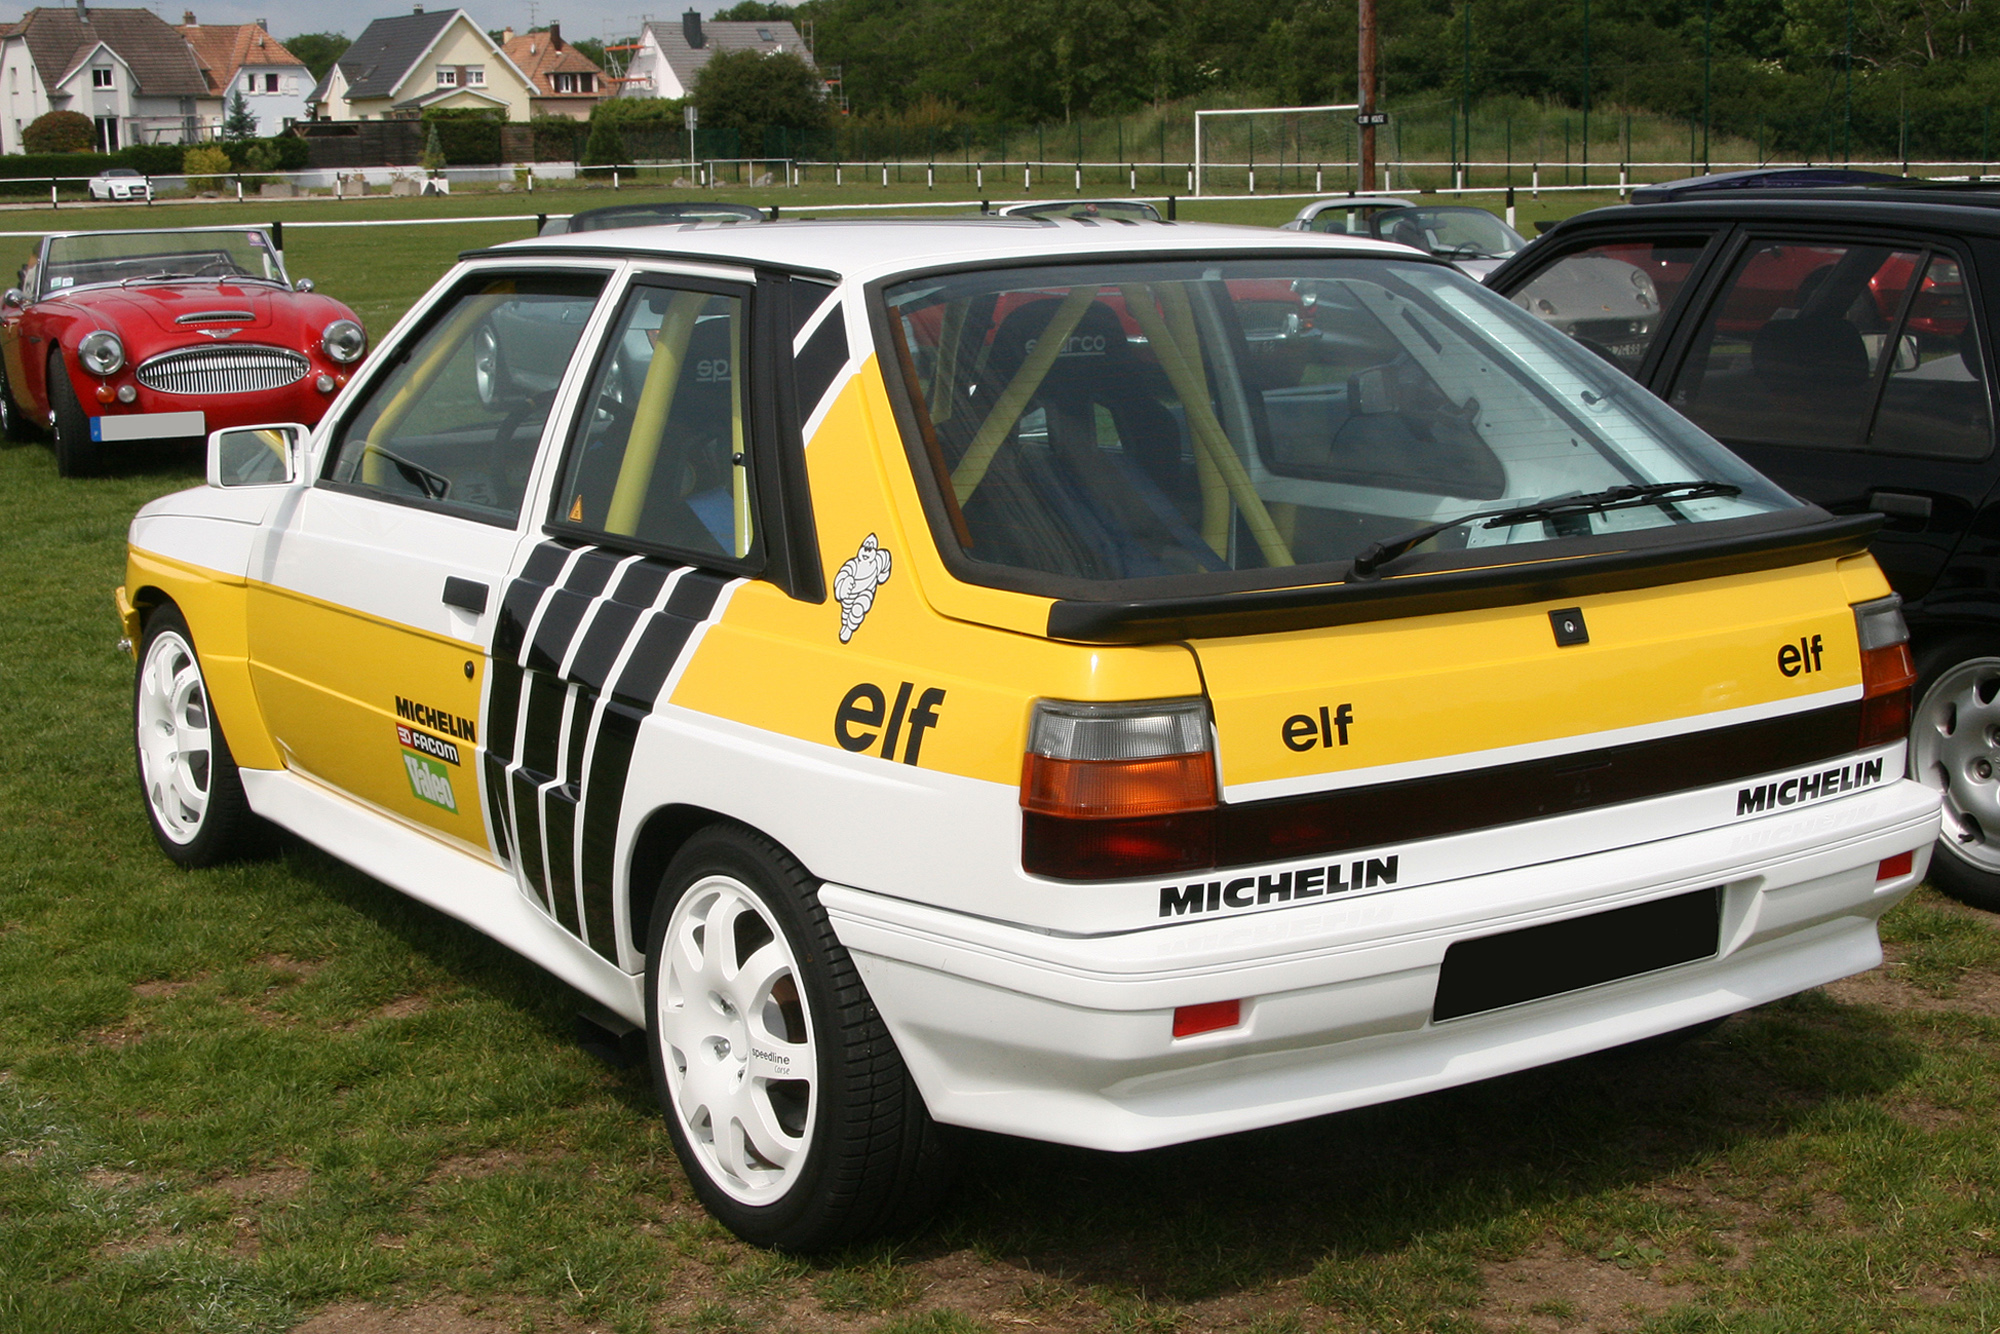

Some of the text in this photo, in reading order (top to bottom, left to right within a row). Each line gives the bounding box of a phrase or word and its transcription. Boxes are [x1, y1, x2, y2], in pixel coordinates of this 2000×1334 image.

[1777, 634, 1823, 677] elf
[395, 695, 476, 743] MICHELIN
[834, 681, 946, 767] elf
[1281, 703, 1353, 752] elf
[412, 731, 459, 763] FACOM
[403, 754, 455, 809] Valeo
[1736, 757, 1883, 816] MICHELIN
[1159, 855, 1398, 917] MICHELIN
[752, 1048, 790, 1065] speedline
